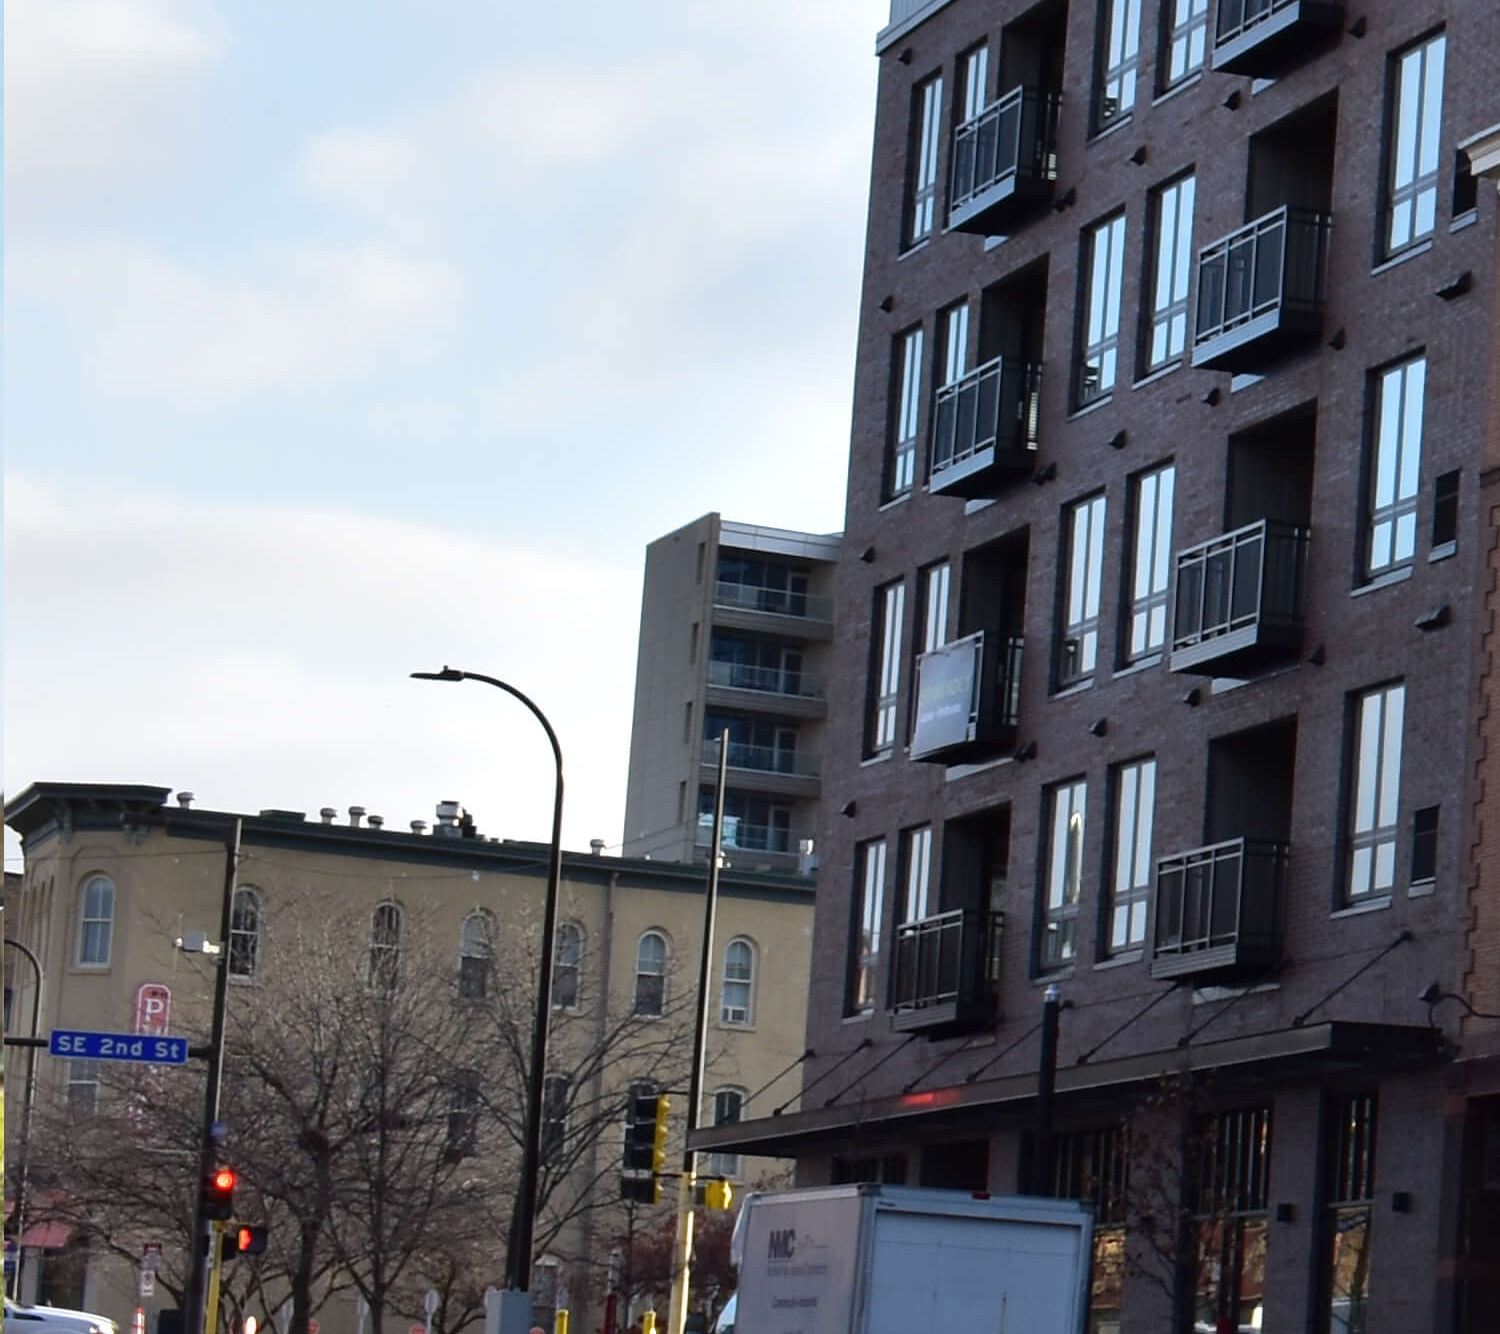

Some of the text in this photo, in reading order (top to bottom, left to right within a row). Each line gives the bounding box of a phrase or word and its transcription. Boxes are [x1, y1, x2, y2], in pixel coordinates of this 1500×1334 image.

[57, 1035, 181, 1059] SE 2nd St
